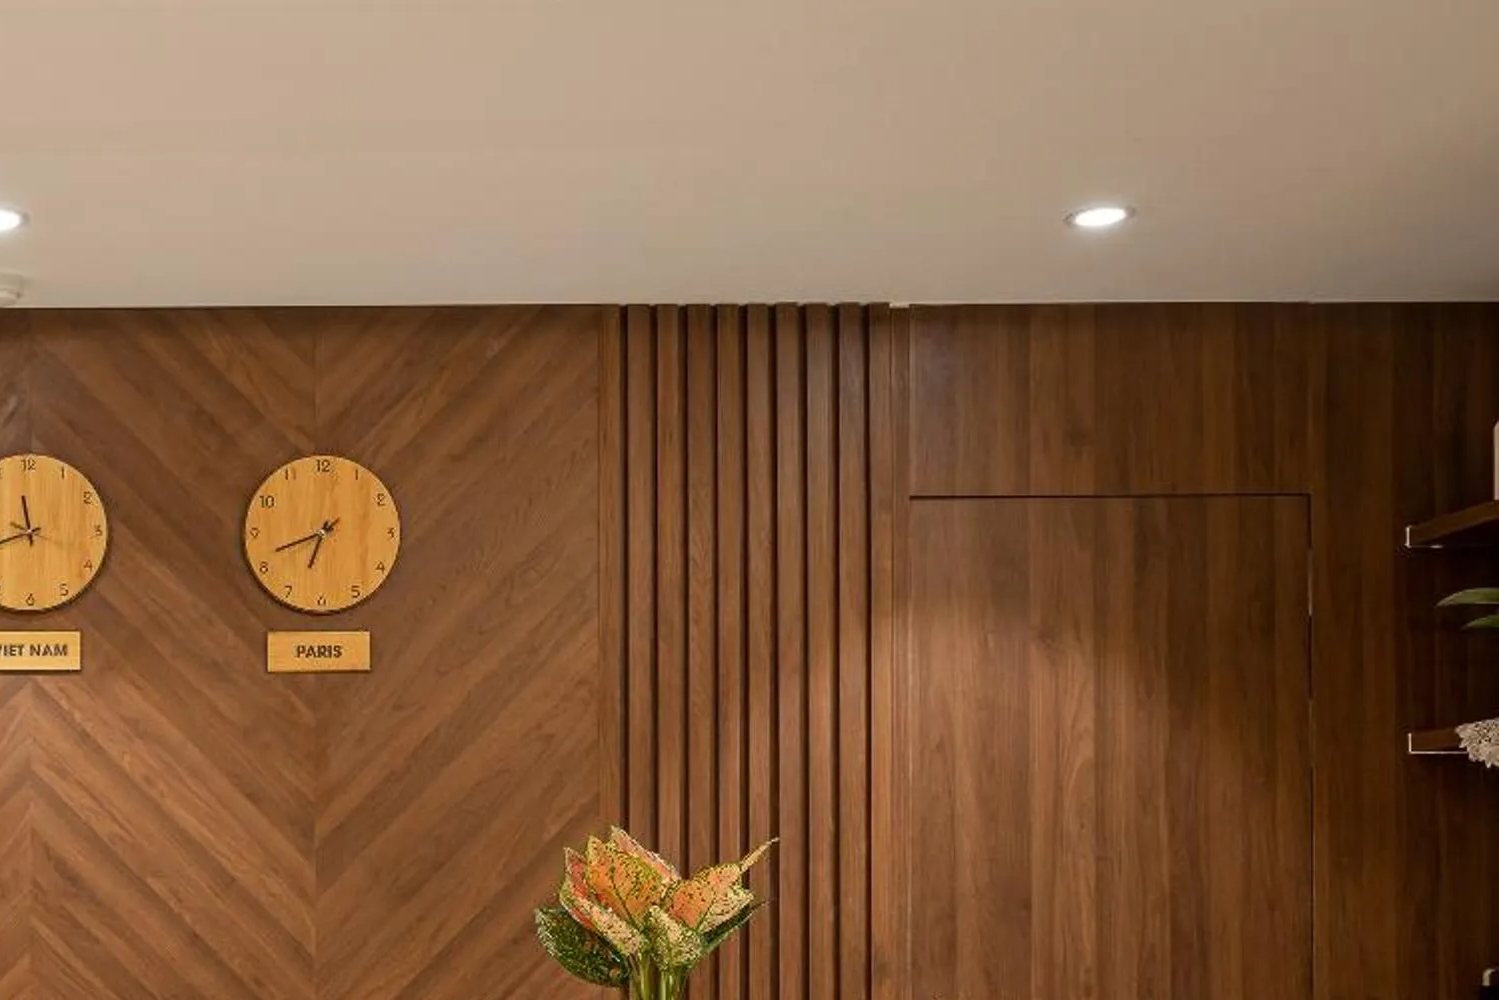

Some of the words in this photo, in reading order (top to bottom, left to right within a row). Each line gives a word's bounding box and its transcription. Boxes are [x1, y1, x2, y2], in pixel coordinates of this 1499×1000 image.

[22, 459, 36, 471] 12
[317, 460, 331, 473] 12
[61, 467, 65, 480] 1
[355, 469, 359, 481] 1
[84, 491, 93, 505] 2
[260, 496, 275, 508] 10
[94, 525, 102, 536] 3
[84, 560, 92, 572] 4
[260, 561, 268, 574] 8
[376, 561, 385, 574] 4
[60, 584, 69, 596] 5
[284, 585, 293, 598] 7
[352, 586, 360, 598] 5
[26, 593, 35, 606] 6
[30, 643, 68, 656] NAM
[297, 644, 342, 658] PARIS
